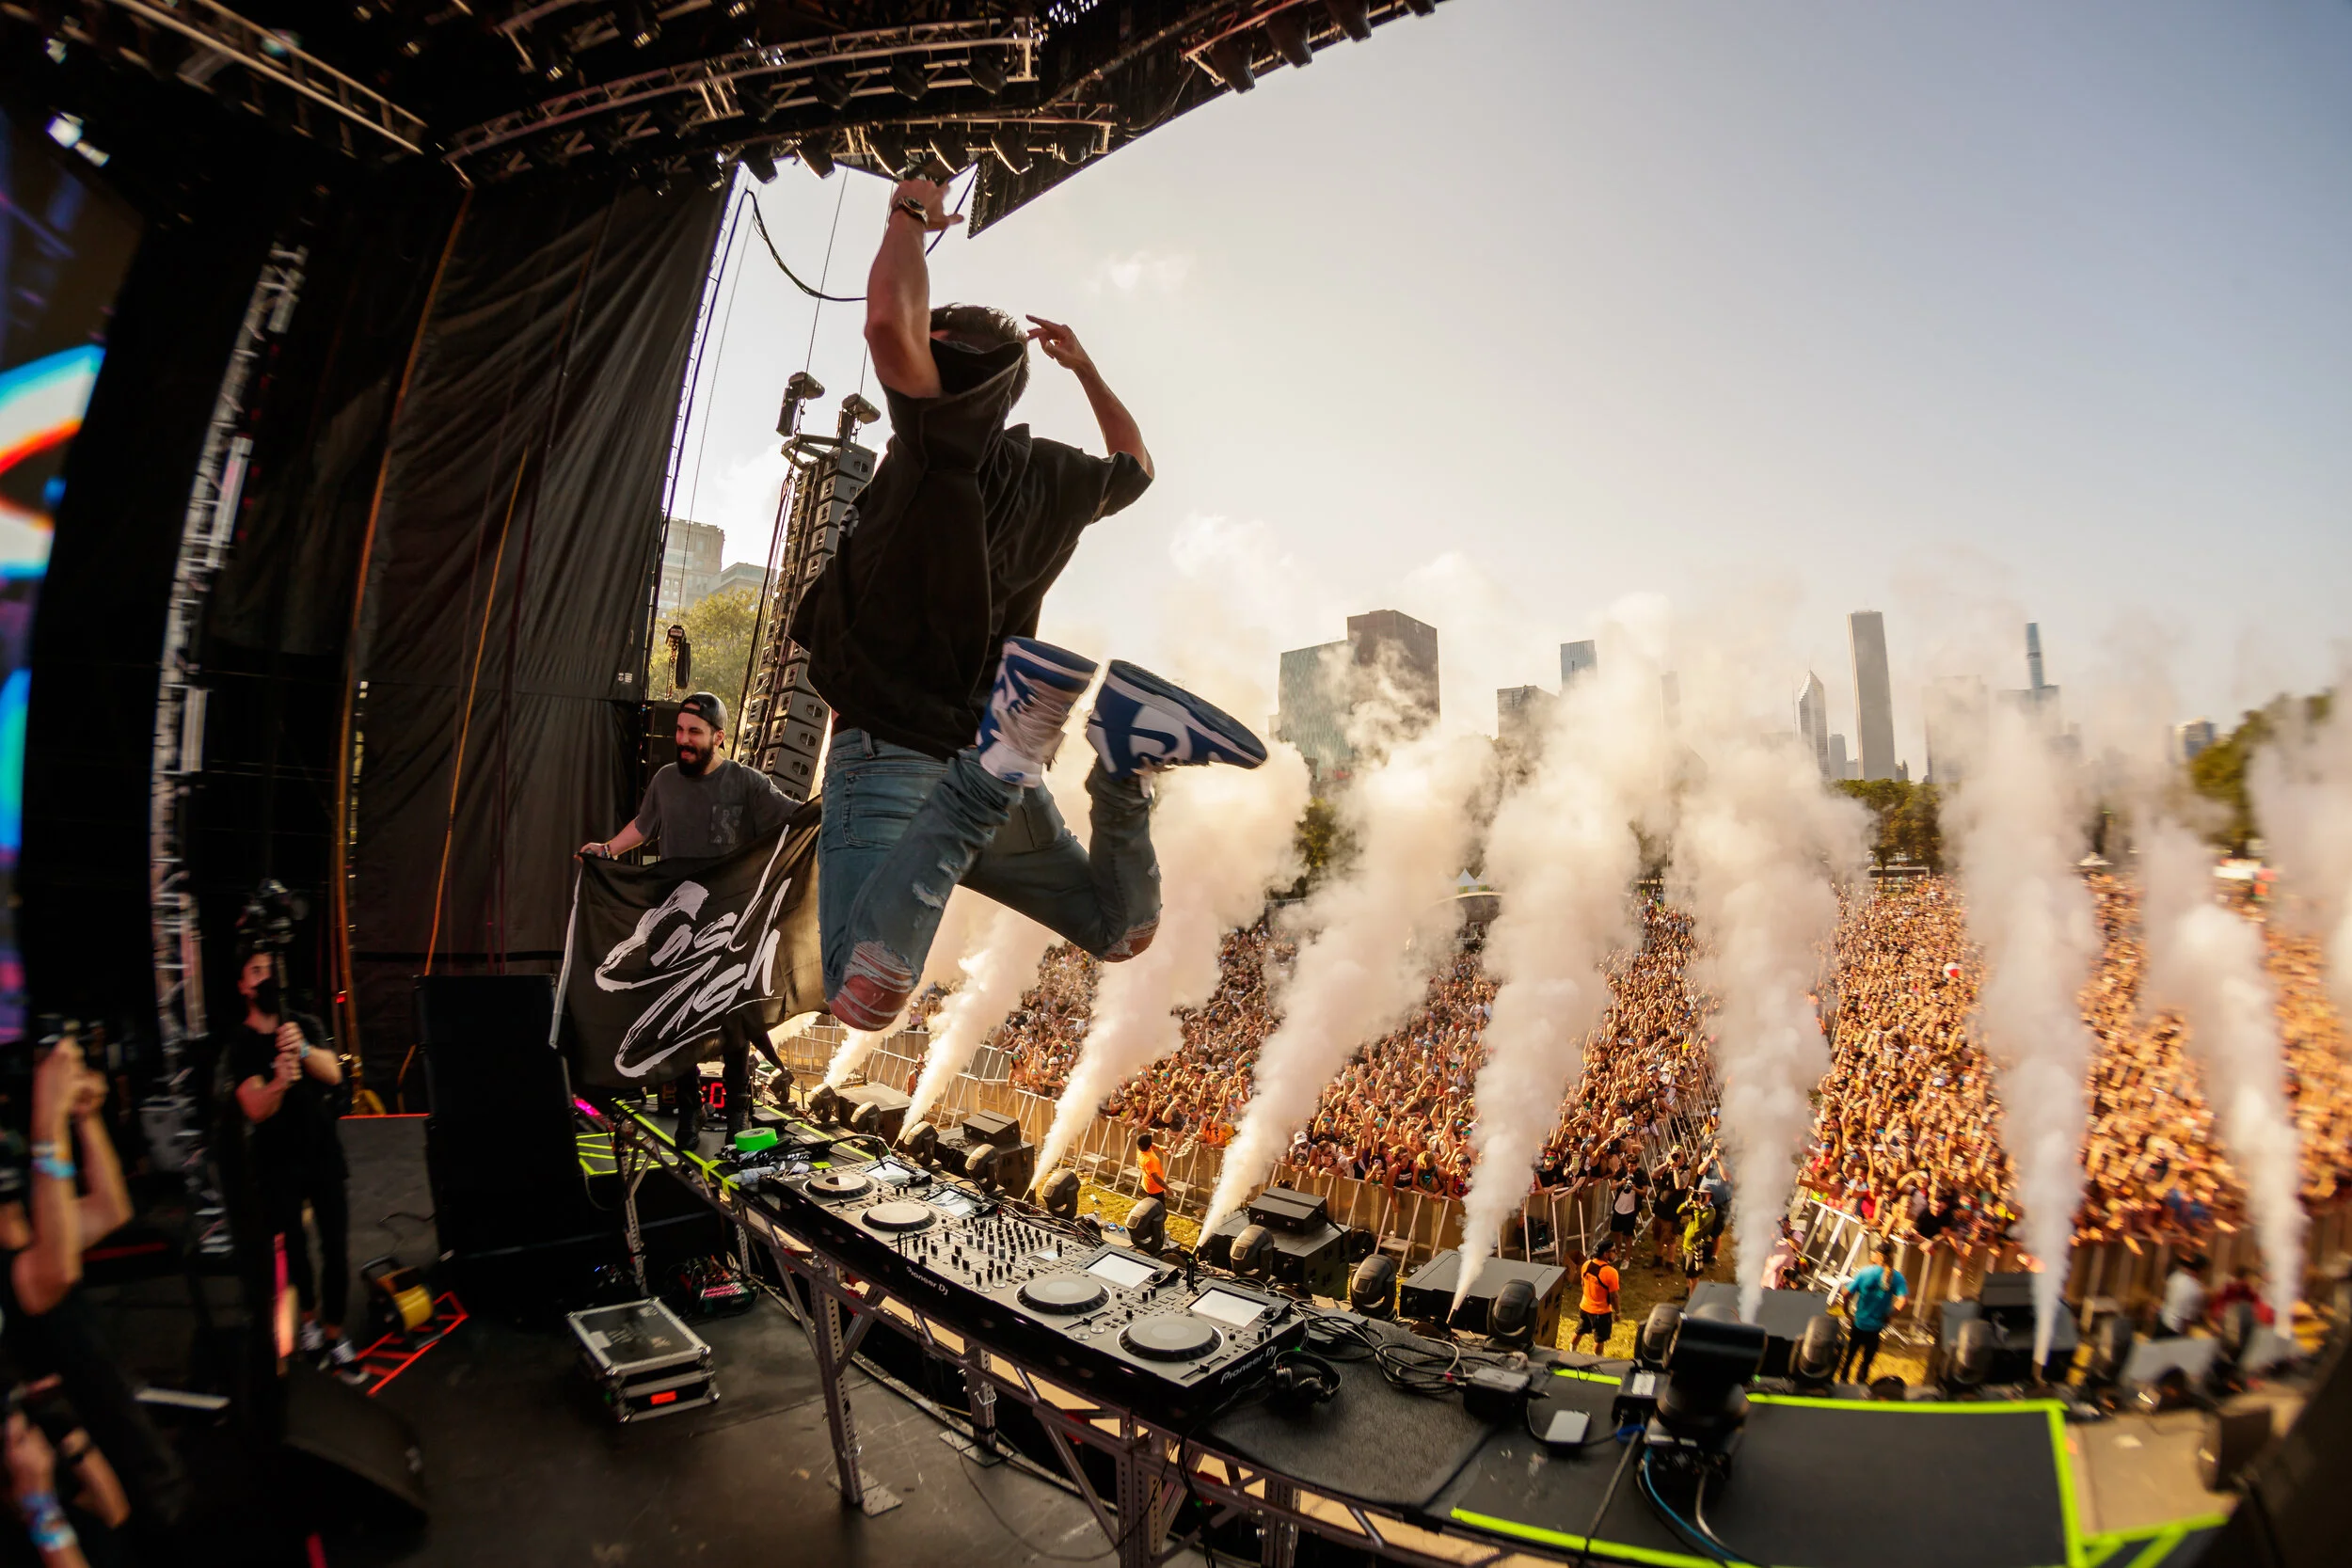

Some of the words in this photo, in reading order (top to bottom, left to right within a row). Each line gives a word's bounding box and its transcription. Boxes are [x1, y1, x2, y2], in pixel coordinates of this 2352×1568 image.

[906, 1266, 937, 1288] Pioneer
[938, 1283, 948, 1296] DJ
[1220, 1354, 1264, 1385] Pioneer
[1265, 1345, 1277, 1357] DJ
